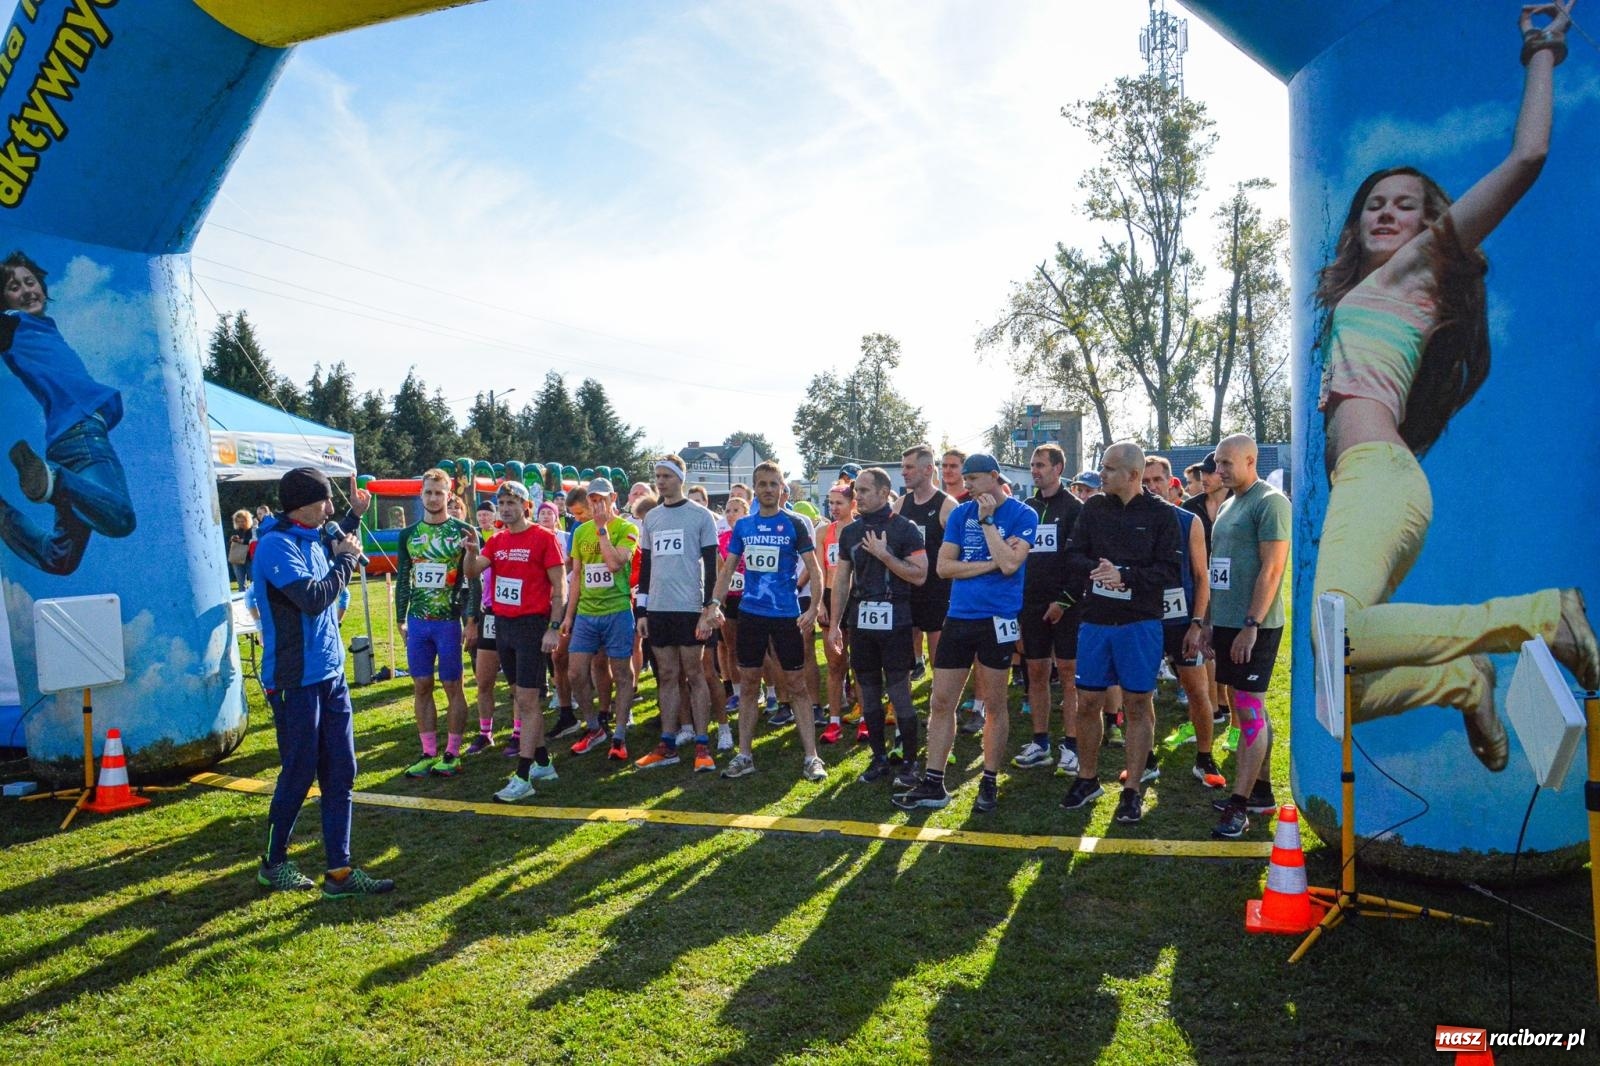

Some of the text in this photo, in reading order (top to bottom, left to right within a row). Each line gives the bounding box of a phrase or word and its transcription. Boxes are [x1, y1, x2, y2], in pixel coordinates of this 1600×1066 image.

[0, 0, 111, 205] aktywny
[654, 537, 682, 552] 176
[742, 535, 790, 545] RUNNERS
[746, 554, 776, 567] 160
[417, 571, 444, 583] 357
[586, 571, 612, 583] 308
[496, 585, 519, 600] 345
[860, 611, 888, 625] 161
